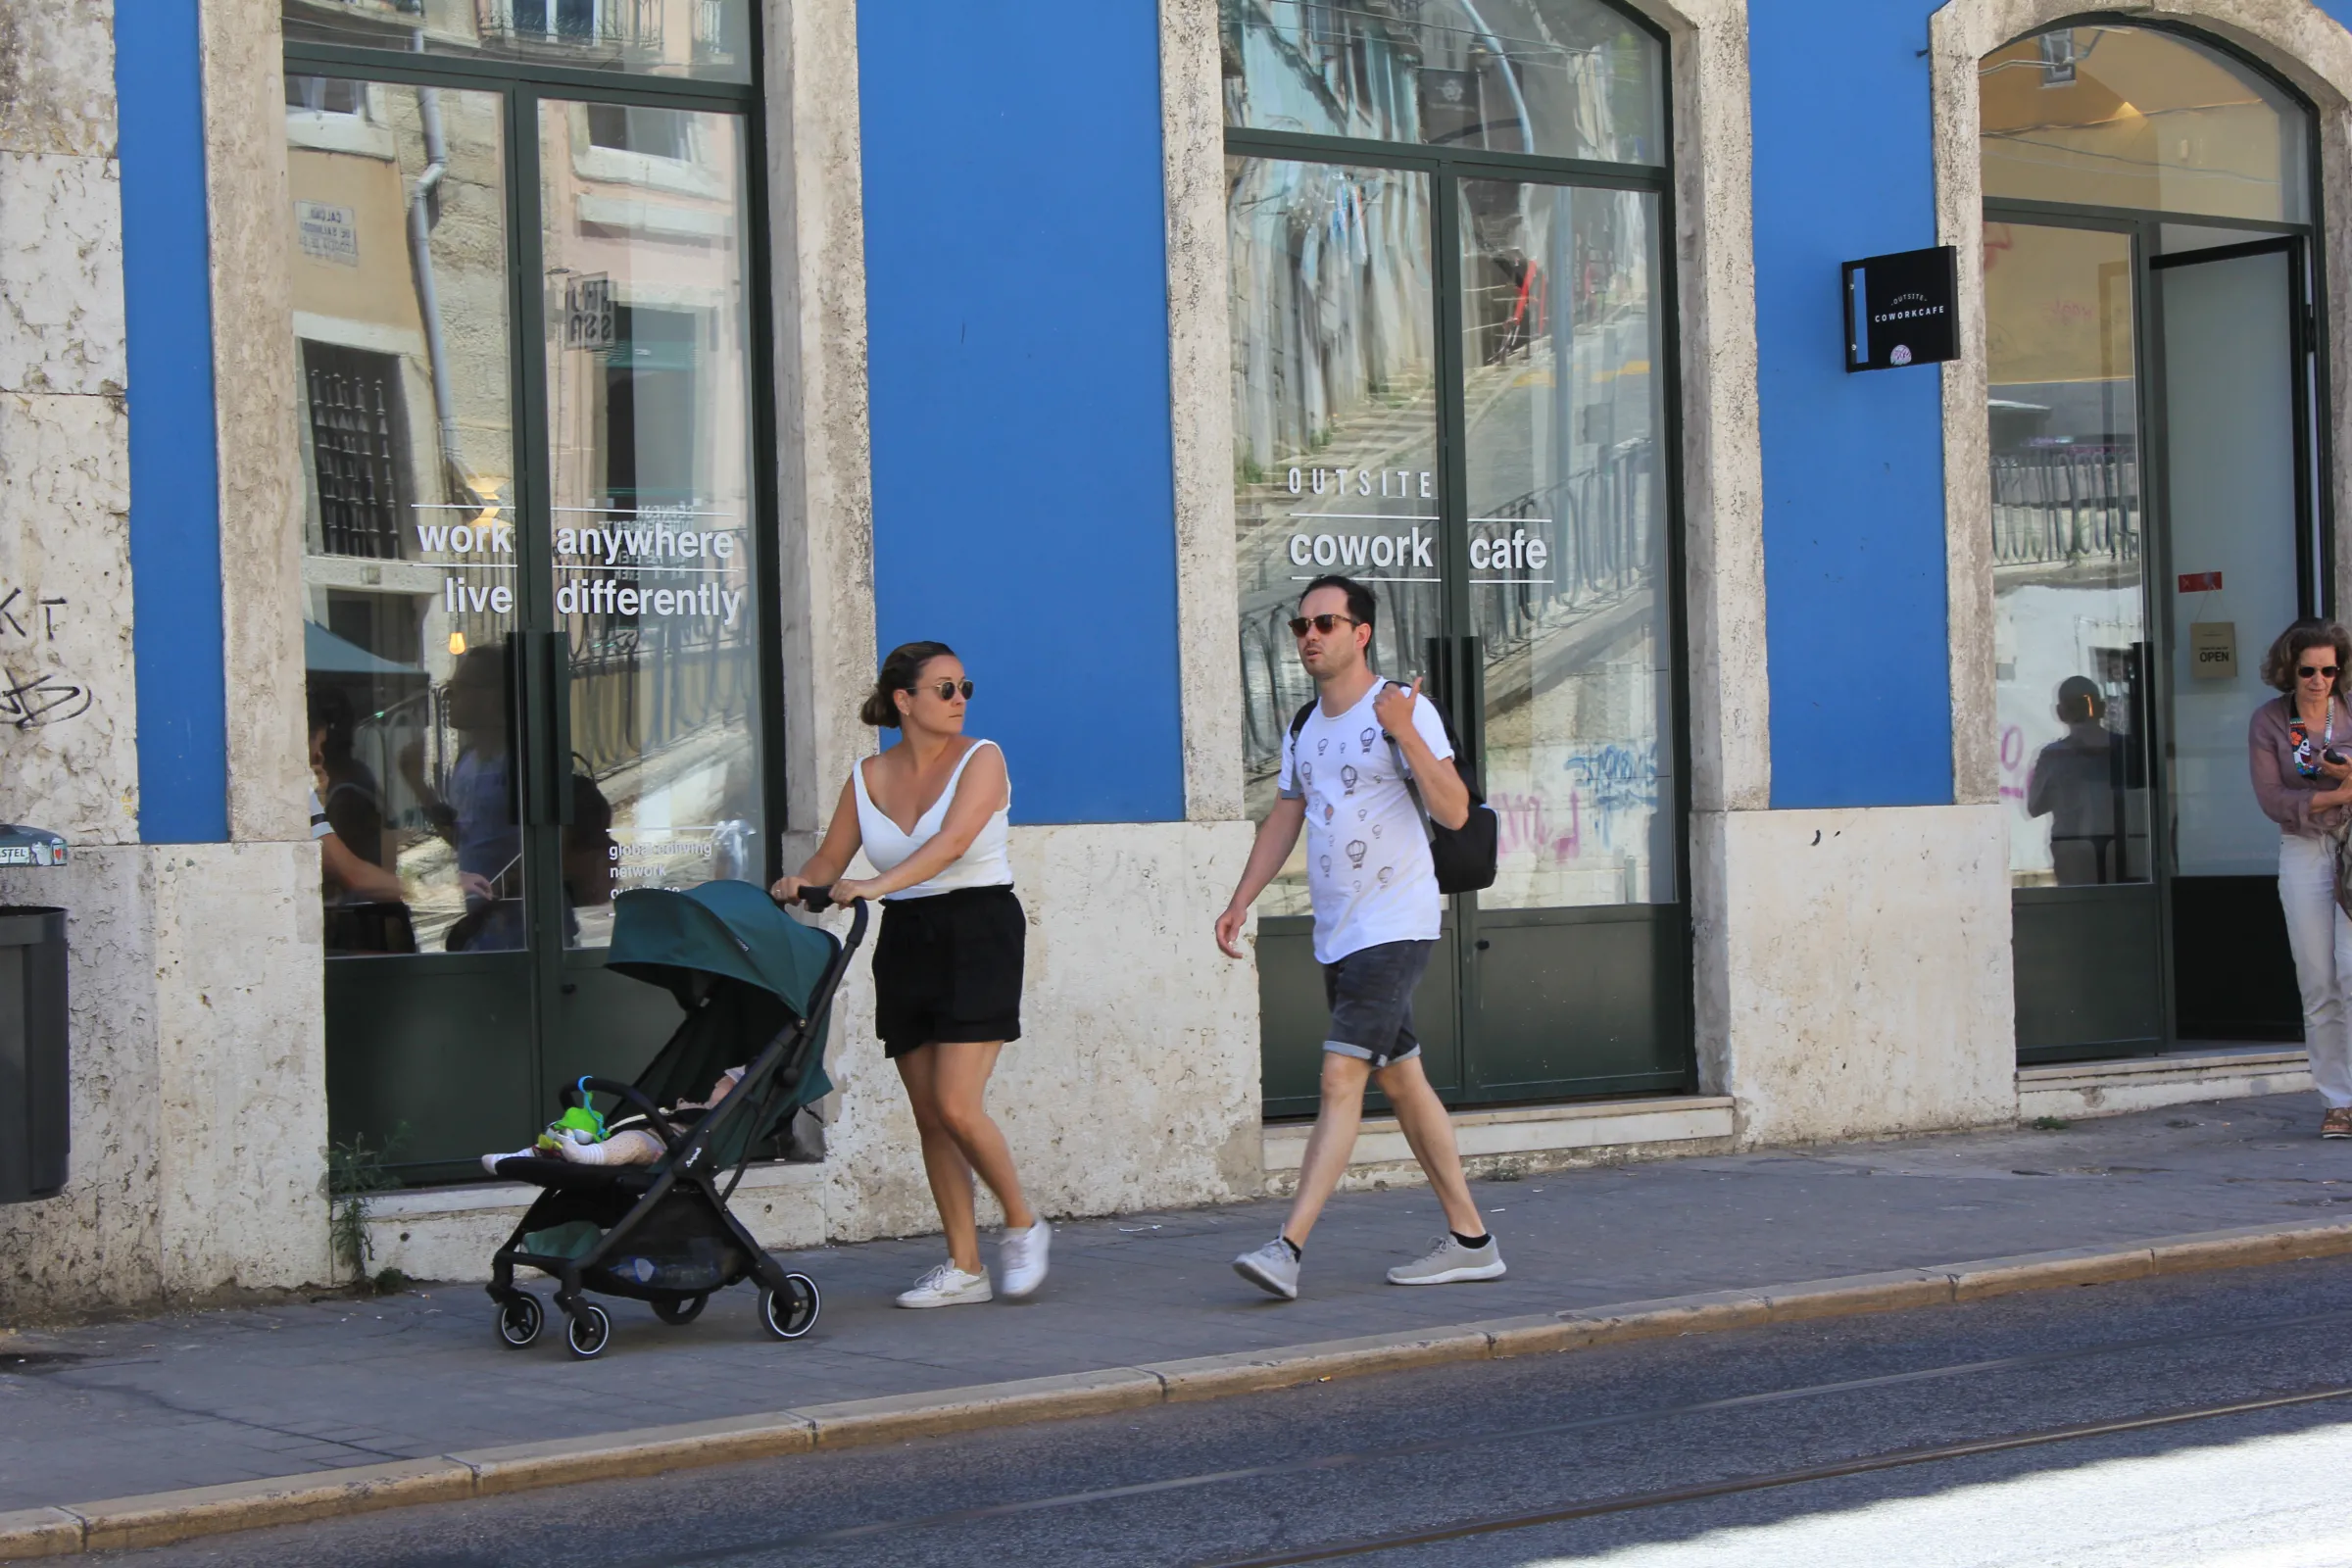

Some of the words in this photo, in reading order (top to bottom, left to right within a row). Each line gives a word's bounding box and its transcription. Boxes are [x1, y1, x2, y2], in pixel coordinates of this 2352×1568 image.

[1893, 294, 1924, 305] OUTSITE
[1875, 306, 1944, 322] COWORKCAFE
[1289, 467, 1431, 498] OUTSITE
[417, 518, 513, 553] work
[557, 523, 734, 564] anywhere
[1290, 527, 1434, 567] cowork
[1470, 529, 1547, 570] cafe
[446, 577, 513, 613] live
[557, 578, 740, 626] differently
[2199, 651, 2230, 662] OPEN
[0, 849, 25, 858] STEL
[610, 864, 667, 878] network
